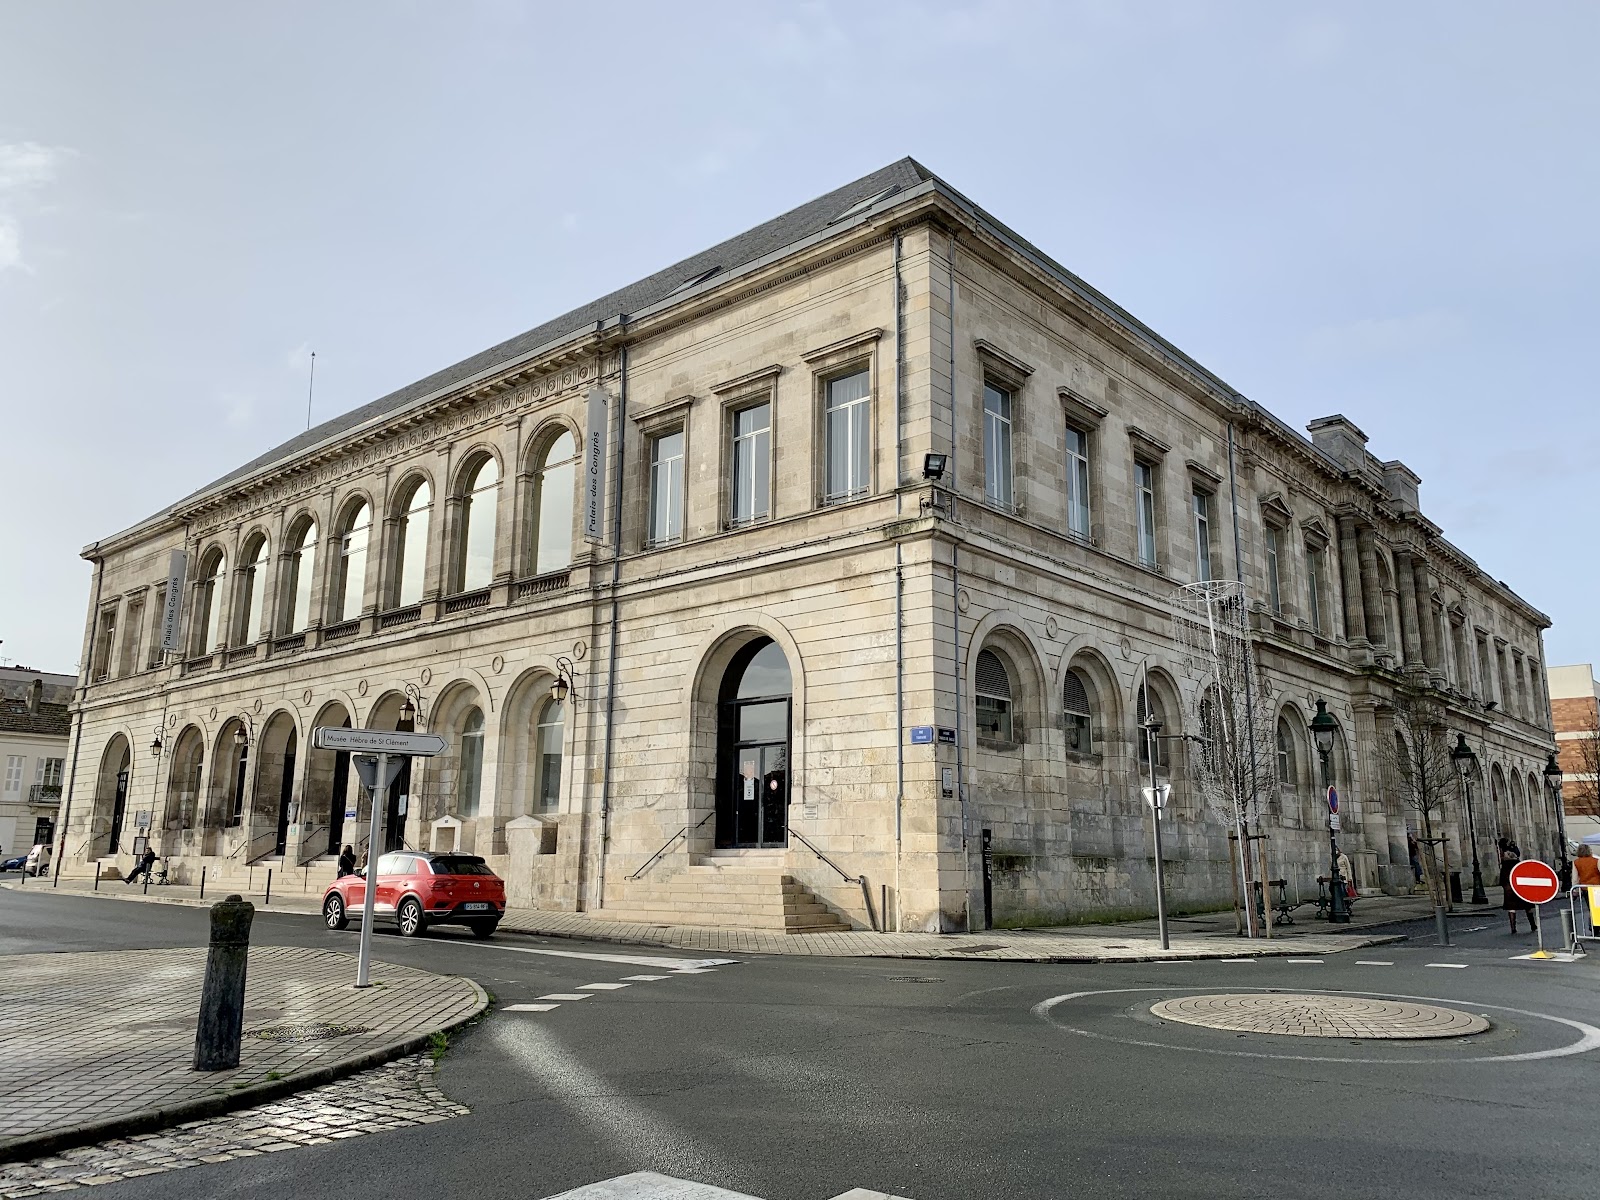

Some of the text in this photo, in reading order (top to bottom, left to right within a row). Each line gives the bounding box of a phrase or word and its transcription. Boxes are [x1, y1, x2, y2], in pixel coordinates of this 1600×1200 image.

[590, 431, 600, 475] Congrès
[588, 500, 597, 532] Palais
[163, 624, 173, 646] Palais
[326, 735, 347, 743] Musée
[385, 738, 409, 746] Clément
